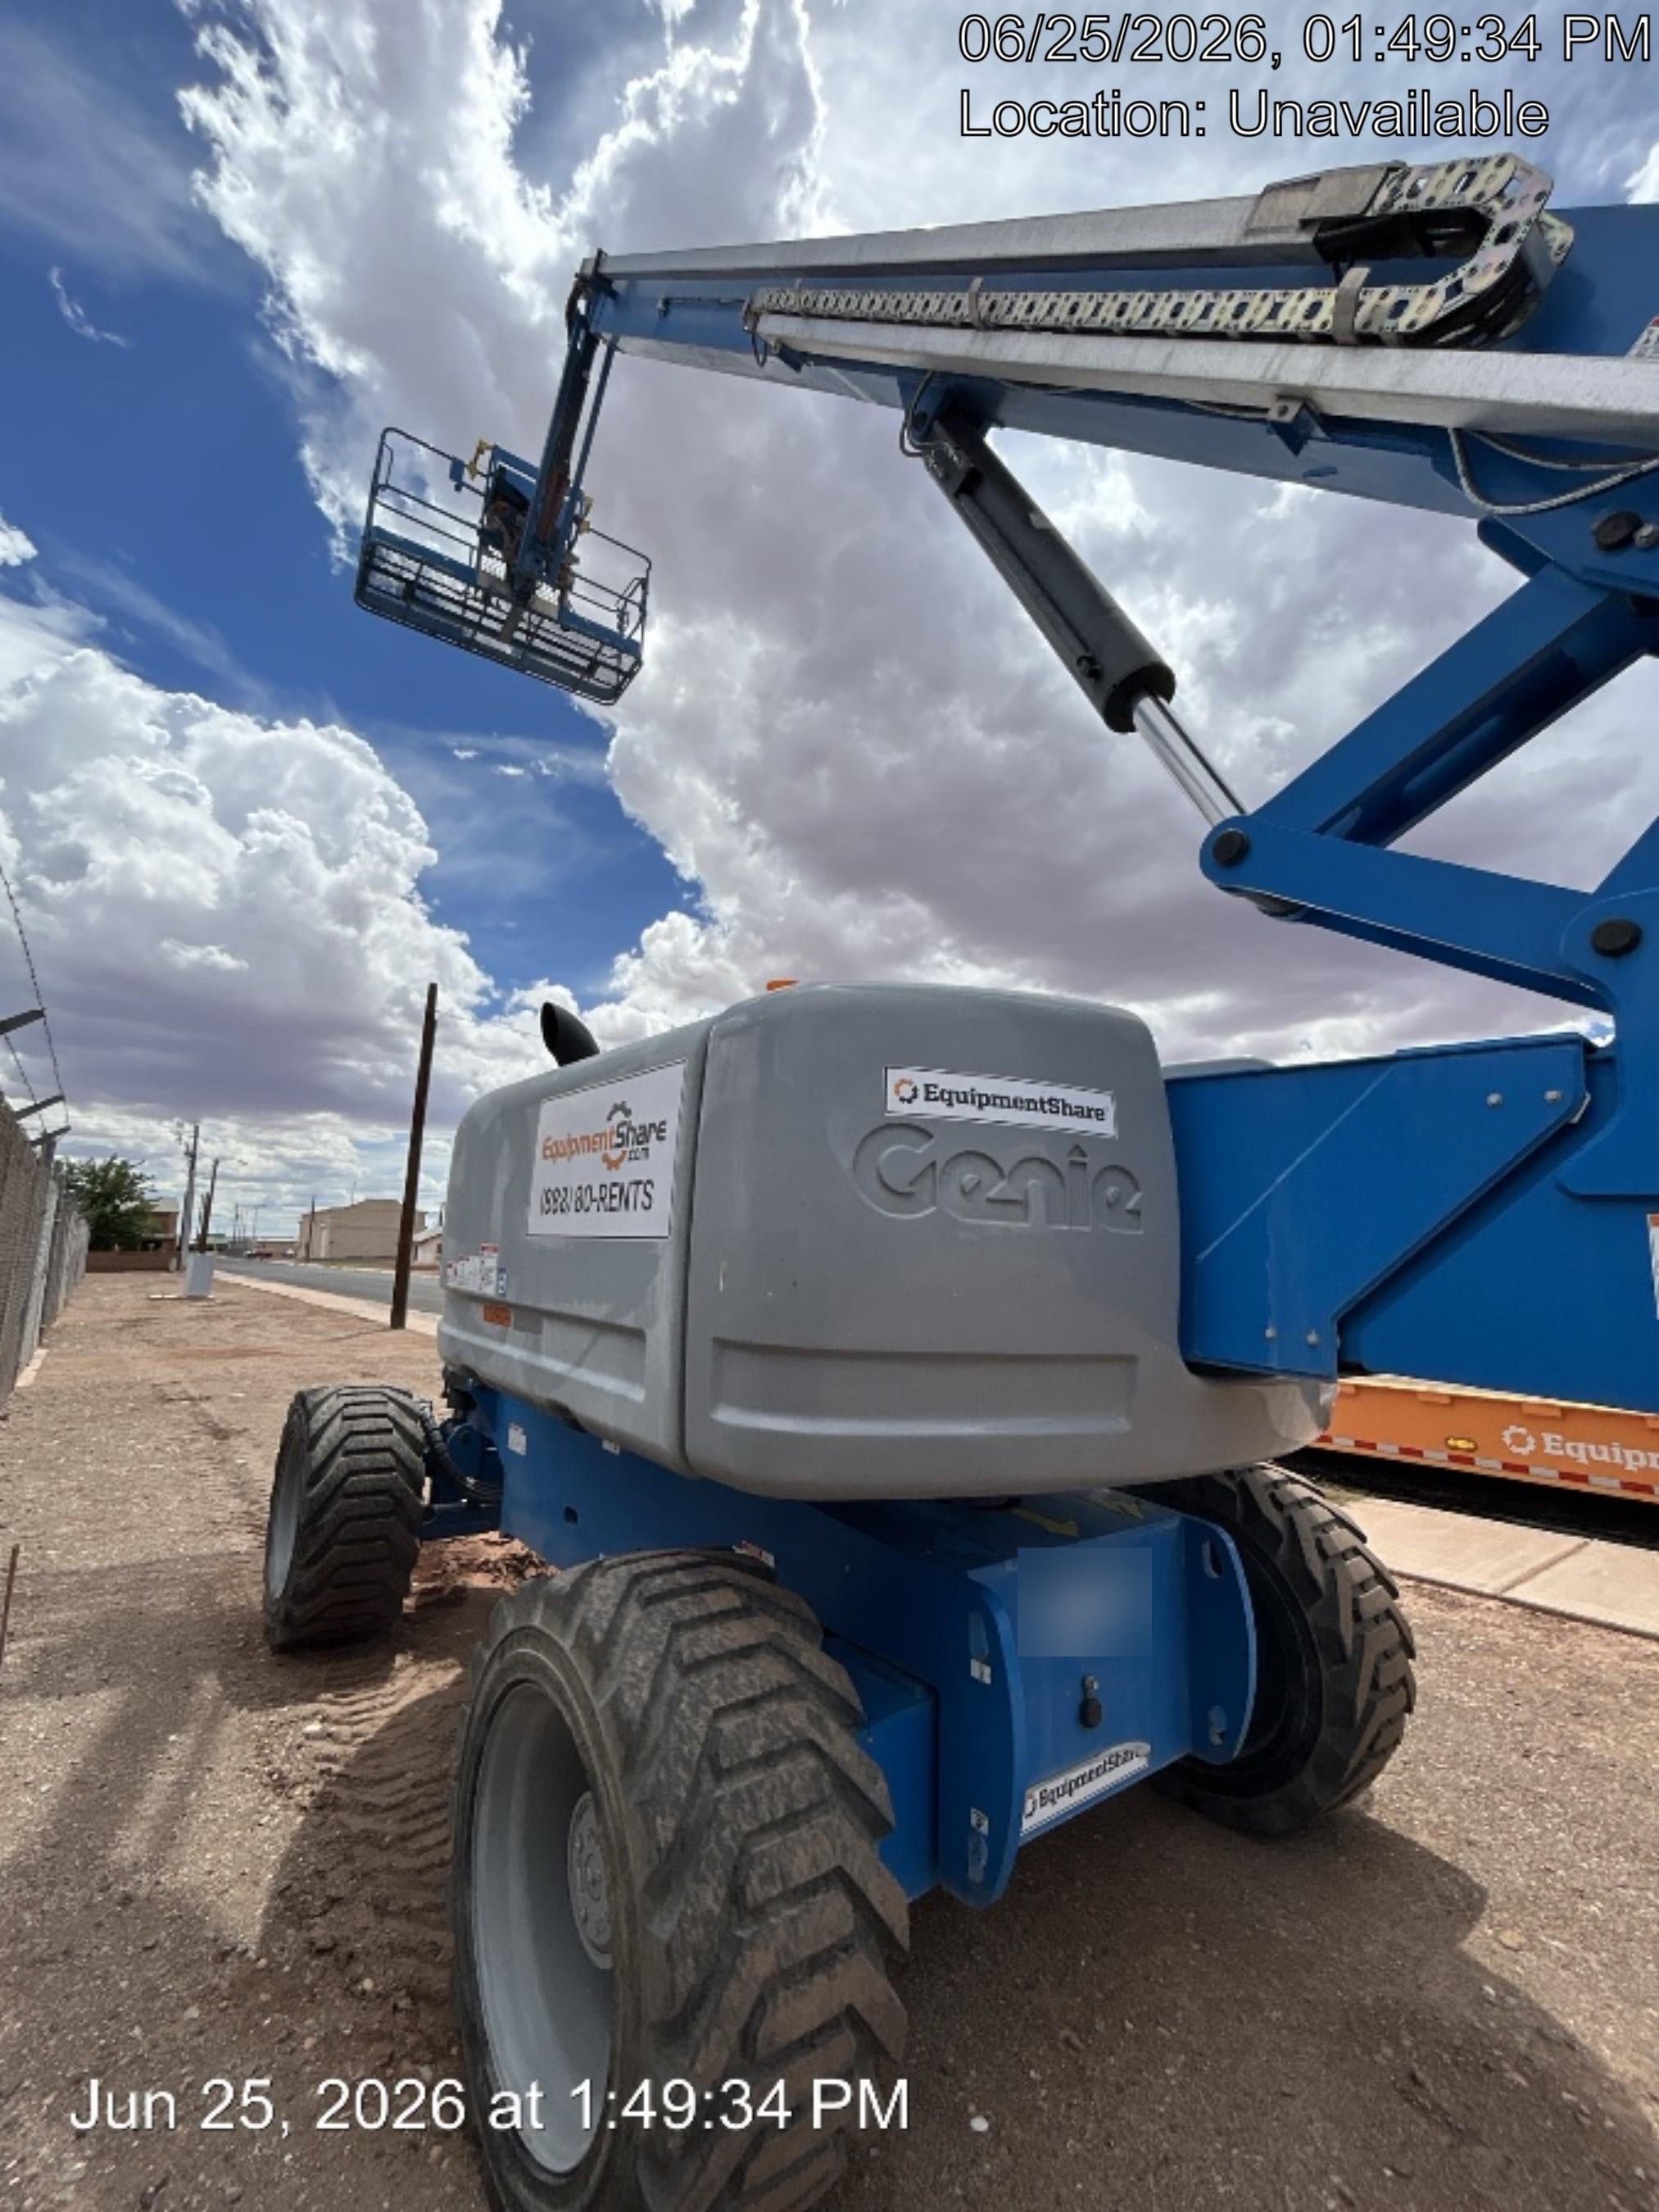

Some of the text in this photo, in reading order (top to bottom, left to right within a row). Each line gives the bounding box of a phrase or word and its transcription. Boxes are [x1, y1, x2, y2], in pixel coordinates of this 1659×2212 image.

[923, 1082, 1107, 1122] EquipmentShare
[543, 1120, 668, 1165] EquipmentShare
[853, 1122, 1144, 1235] Genie
